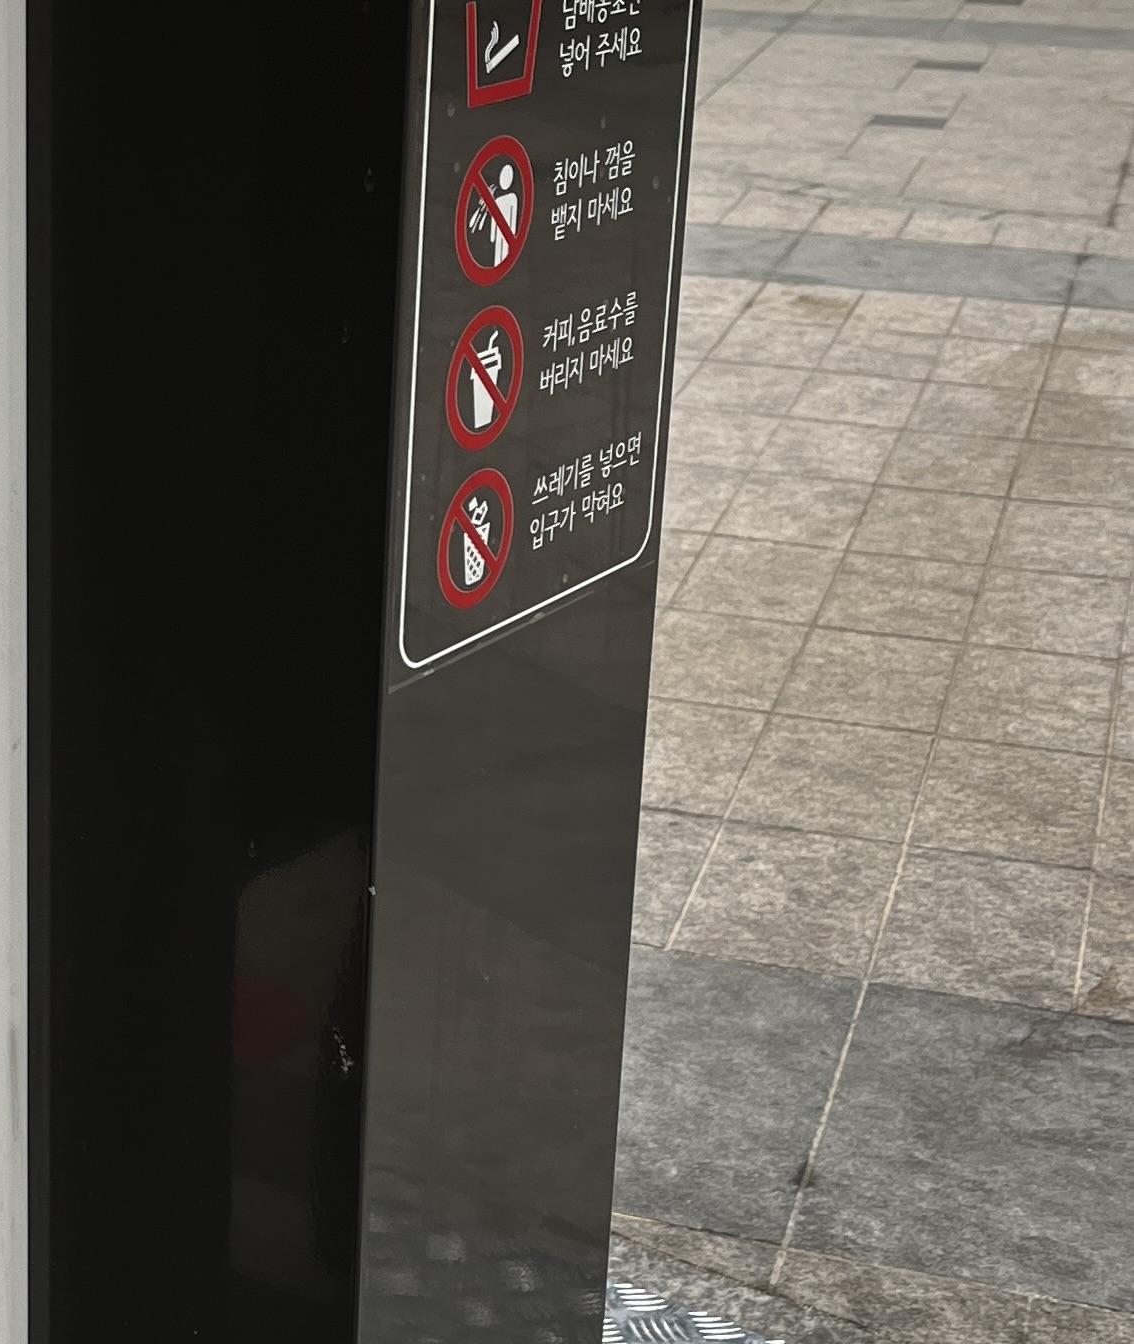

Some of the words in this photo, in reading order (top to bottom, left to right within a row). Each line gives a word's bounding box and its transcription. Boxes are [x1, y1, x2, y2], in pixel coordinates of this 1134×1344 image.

[559, 34, 591, 78] 넣어
[594, 26, 643, 68] 주세요
[553, 149, 601, 196] 침이나
[604, 140, 636, 180] 껌을
[551, 197, 583, 241] 뱉지
[587, 186, 634, 226] 마세요
[542, 291, 639, 353] 커피,음료수를
[539, 350, 585, 396] 버리지
[589, 336, 634, 377] 마세요
[531, 453, 595, 505] 쓰레기를
[599, 431, 642, 478] 넣으면
[529, 499, 577, 551] 입구가
[581, 482, 625, 524] 막혀요
